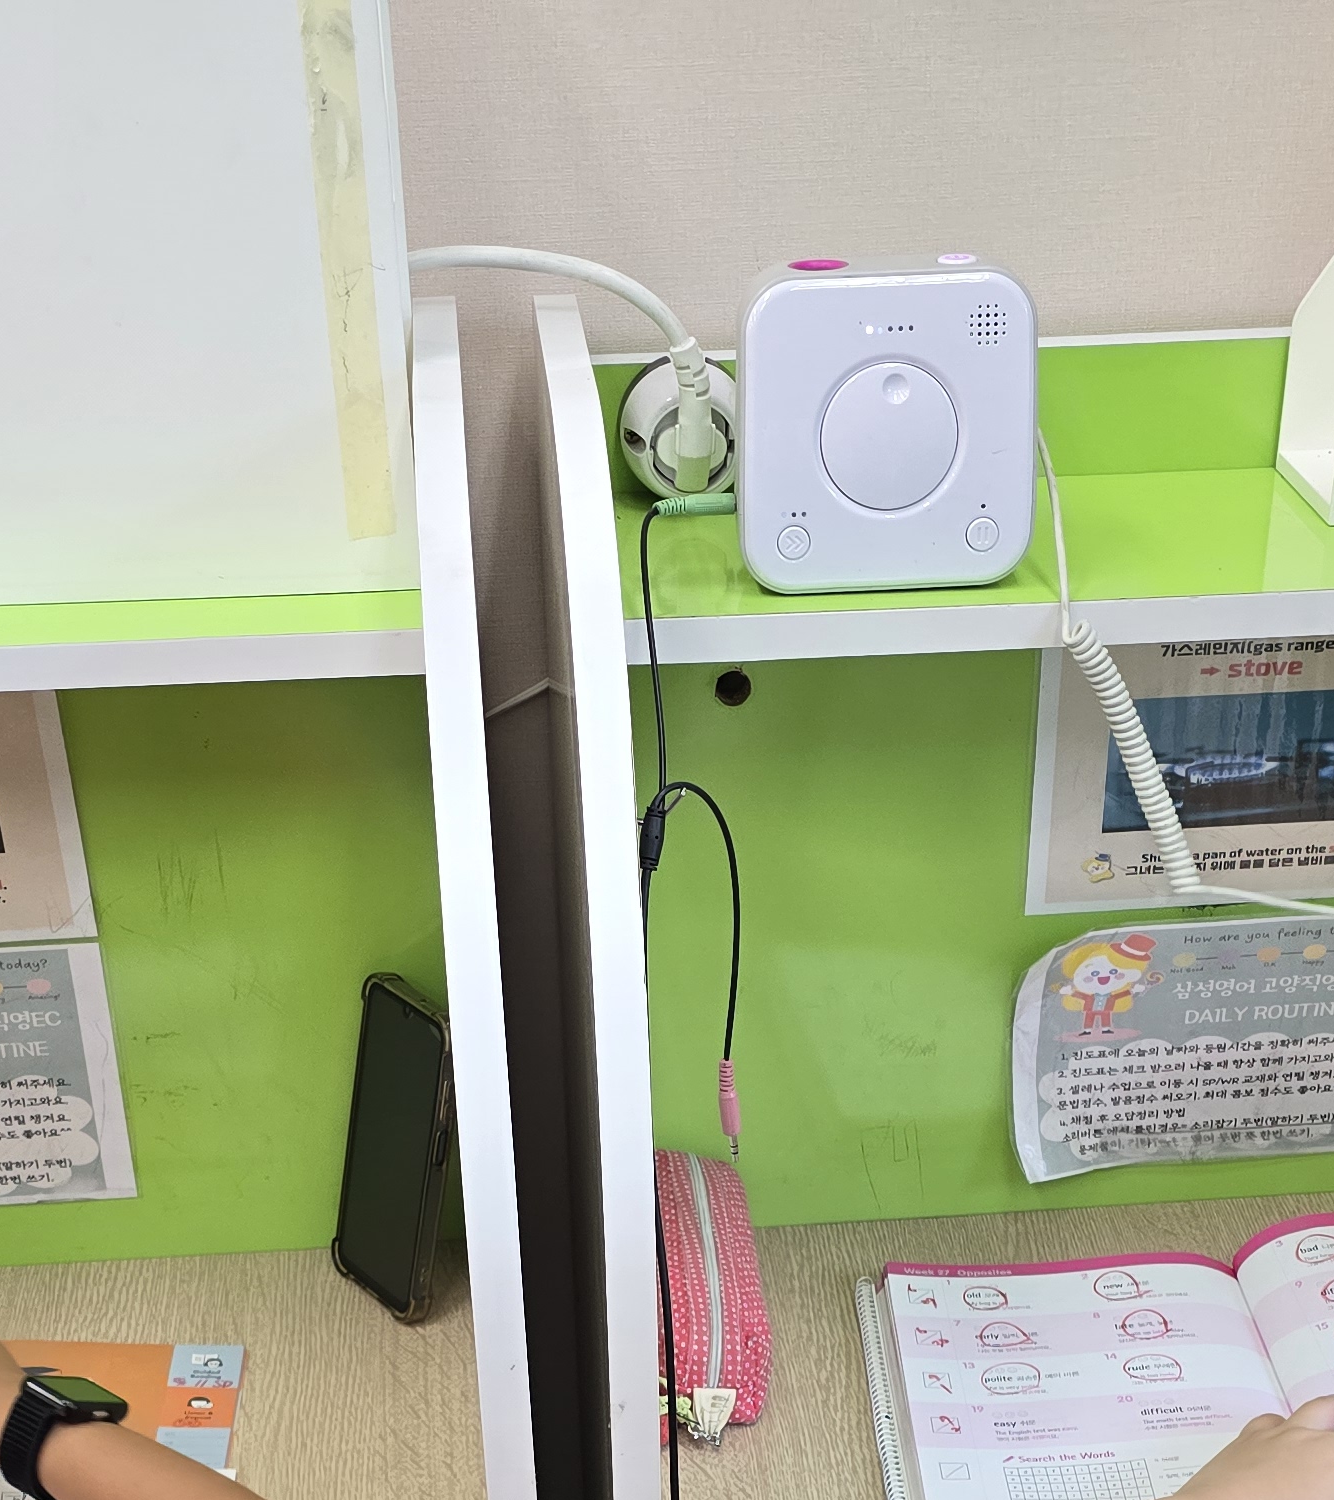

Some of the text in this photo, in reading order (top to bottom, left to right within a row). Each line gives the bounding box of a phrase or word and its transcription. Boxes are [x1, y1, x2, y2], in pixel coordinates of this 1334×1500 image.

[1161, 641, 1283, 657] 가스레인지(gas
[1228, 659, 1303, 678] stove
[1203, 851, 1227, 861] pan
[1229, 848, 1243, 858] of
[1246, 847, 1285, 858] water
[1286, 847, 1302, 855] on
[1305, 844, 1327, 855] the
[1125, 865, 1164, 876] 그녀는
[1210, 860, 1236, 871] 위에
[1184, 935, 1212, 944] How
[1218, 934, 1240, 942] are
[1244, 931, 1270, 943] you
[1278, 927, 1322, 940] feeling
[0, 958, 48, 972] today?
[1172, 978, 1256, 1000] 삼성영어
[1184, 1006, 1249, 1024] DAILY
[1072, 1048, 1120, 1060] 진도표에
[1123, 1046, 1159, 1057] 오늘의
[1164, 1044, 1200, 1056] 날짜와
[1268, 1038, 1303, 1049] 정확히
[1071, 1067, 1119, 1078] 진도표는
[1122, 1065, 1147, 1074] 체크
[1217, 1059, 1228, 1069] 때
[1108, 1081, 1156, 1091] 수업으로
[1202, 1077, 1239, 1086] SP/WR
[1242, 1073, 1278, 1084] 교재와
[1282, 1071, 1305, 1082] 연필
[1, 1115, 26, 1126] 연필
[1300, 1244, 1319, 1254] bad
[904, 1266, 1013, 1277] Week Opposites
[1315, 1322, 1329, 1331] 15
[1128, 1363, 1150, 1372] rude
[984, 1373, 1013, 1384] polite
[1117, 1395, 1134, 1403] 20
[1140, 1406, 1184, 1416] difficult
[993, 1421, 1017, 1429] easy
[1017, 1450, 1116, 1464] Search the Words
